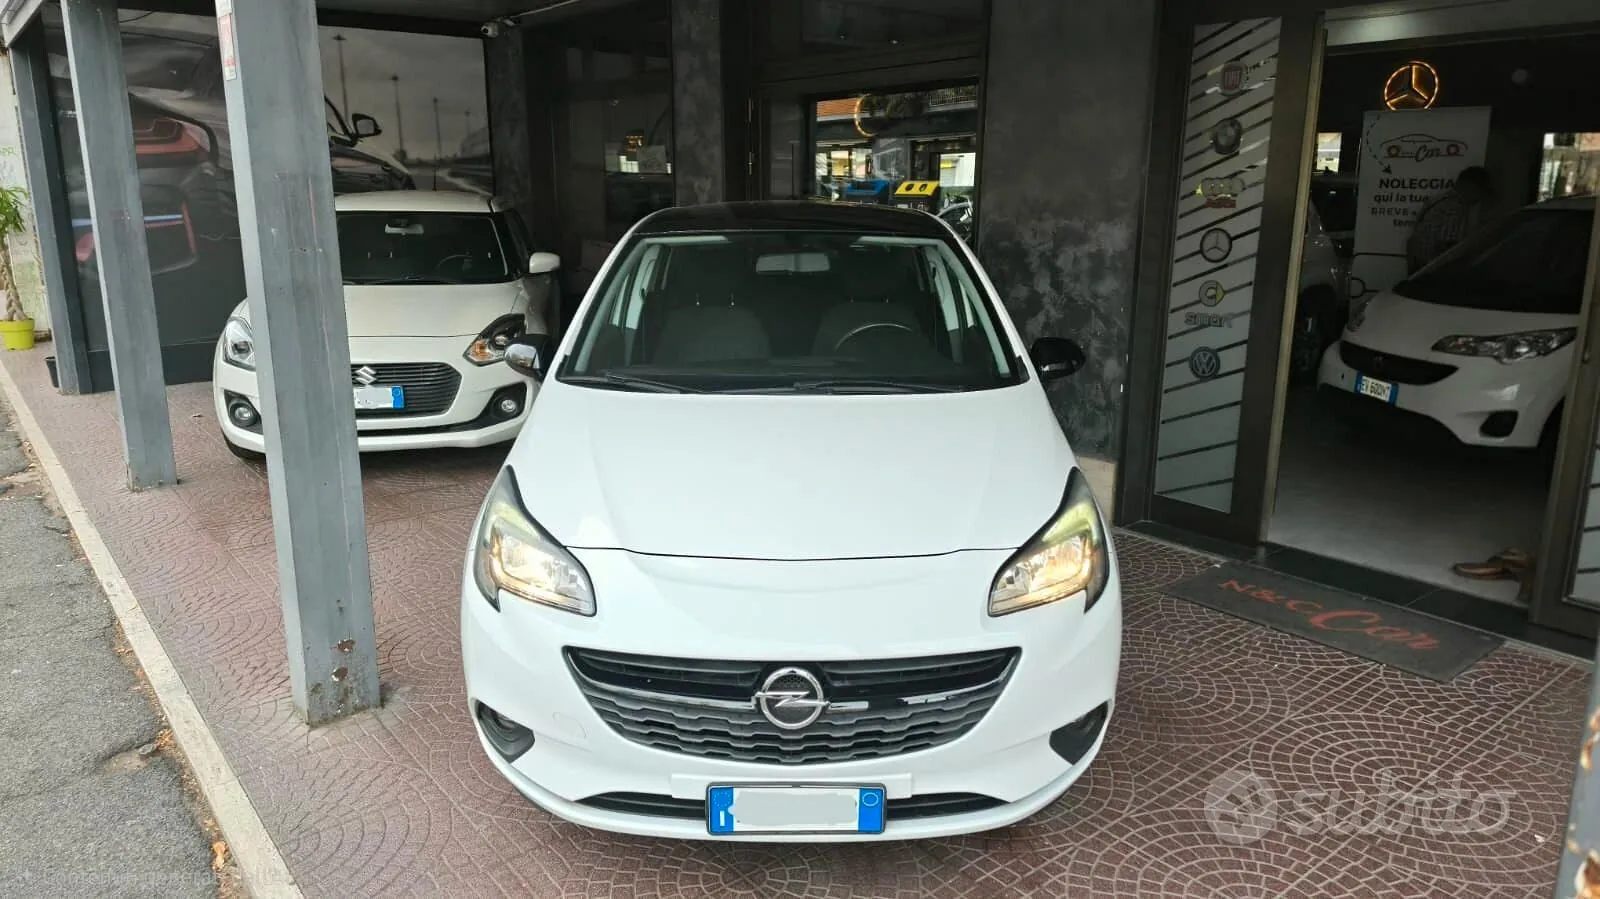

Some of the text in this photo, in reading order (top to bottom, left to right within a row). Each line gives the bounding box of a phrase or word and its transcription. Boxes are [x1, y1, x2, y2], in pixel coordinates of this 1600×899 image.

[1379, 178, 1455, 190] NOLEGGIA
[1374, 192, 1393, 204] qui
[1396, 192, 1406, 202] la
[1371, 207, 1408, 216] BREVE
